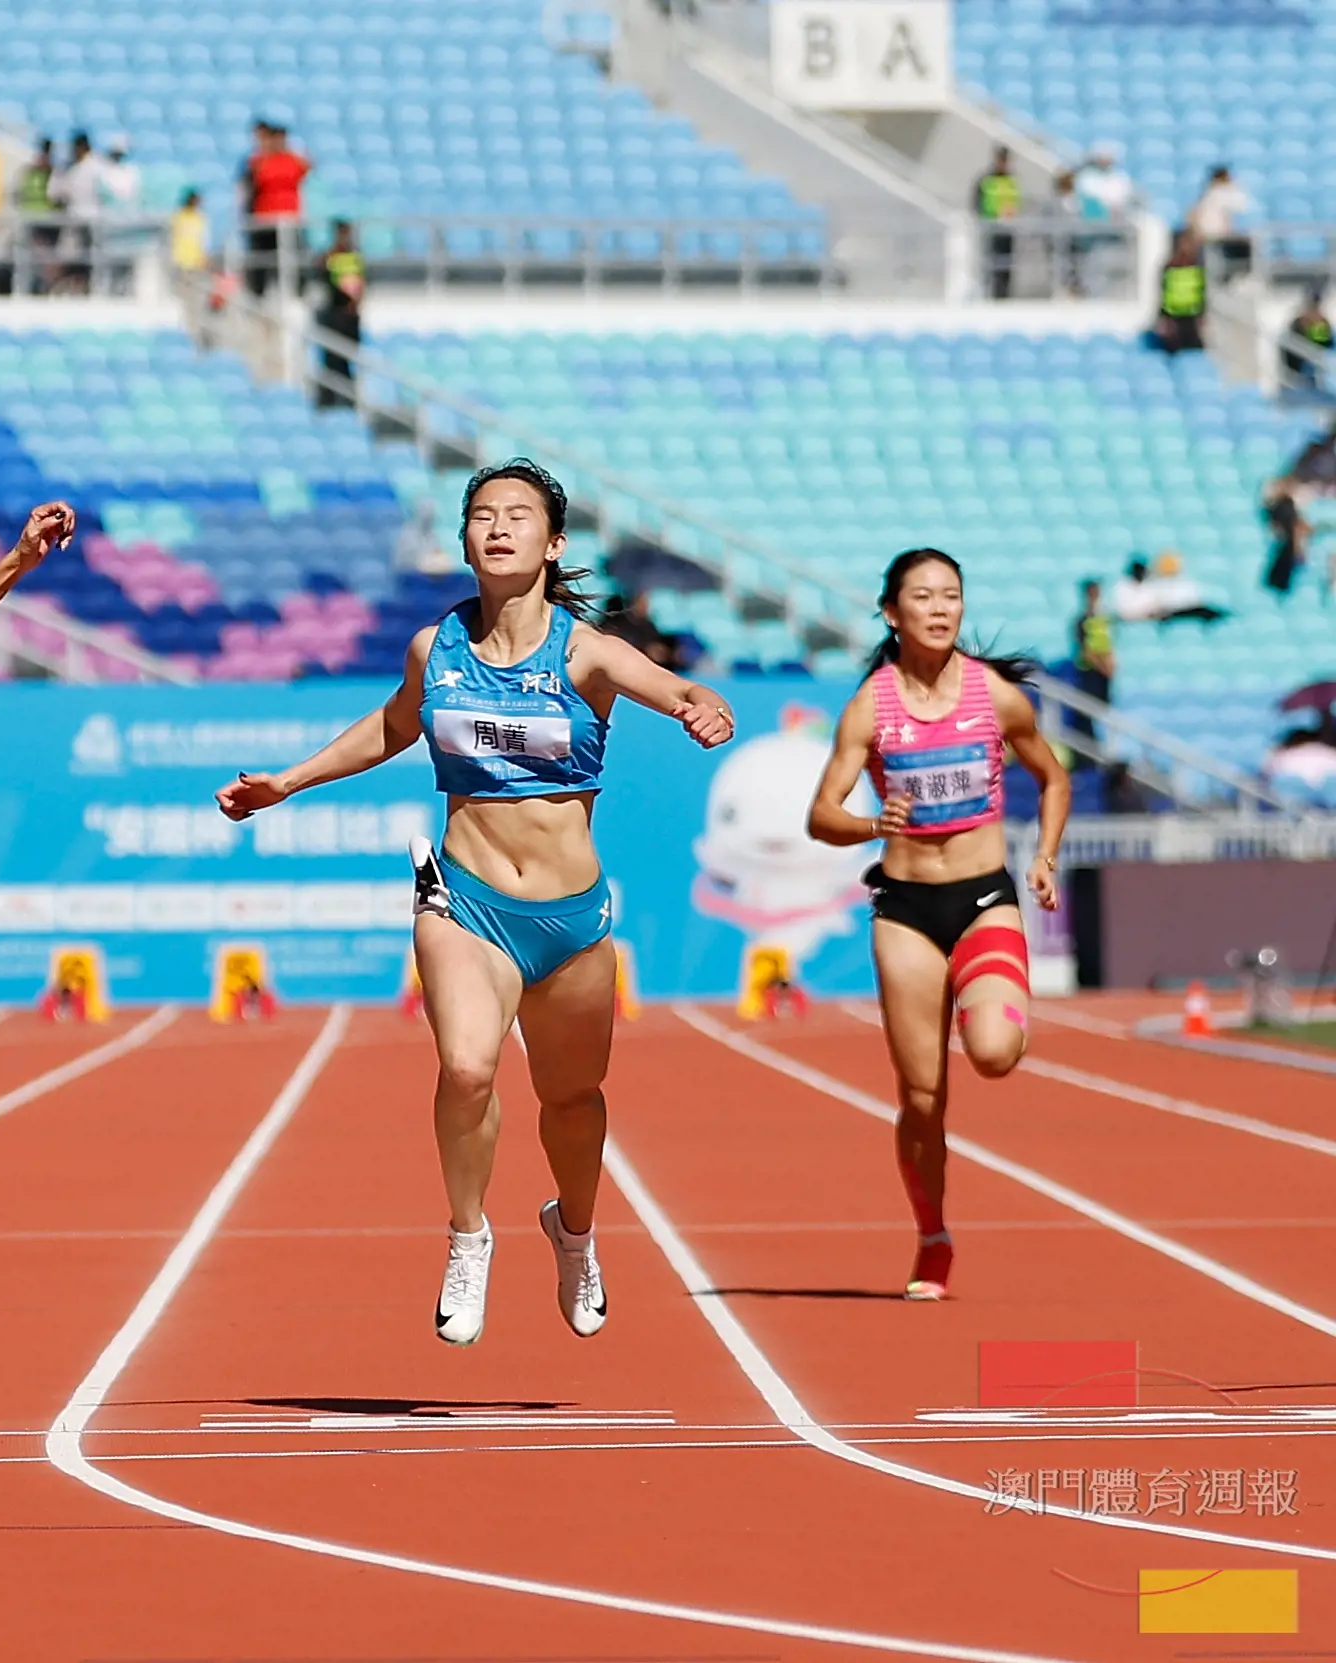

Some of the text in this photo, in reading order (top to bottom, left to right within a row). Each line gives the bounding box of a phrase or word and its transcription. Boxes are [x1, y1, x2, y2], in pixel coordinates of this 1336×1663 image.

[803, 18, 929, 78] B A
[474, 720, 527, 752] 周菁
